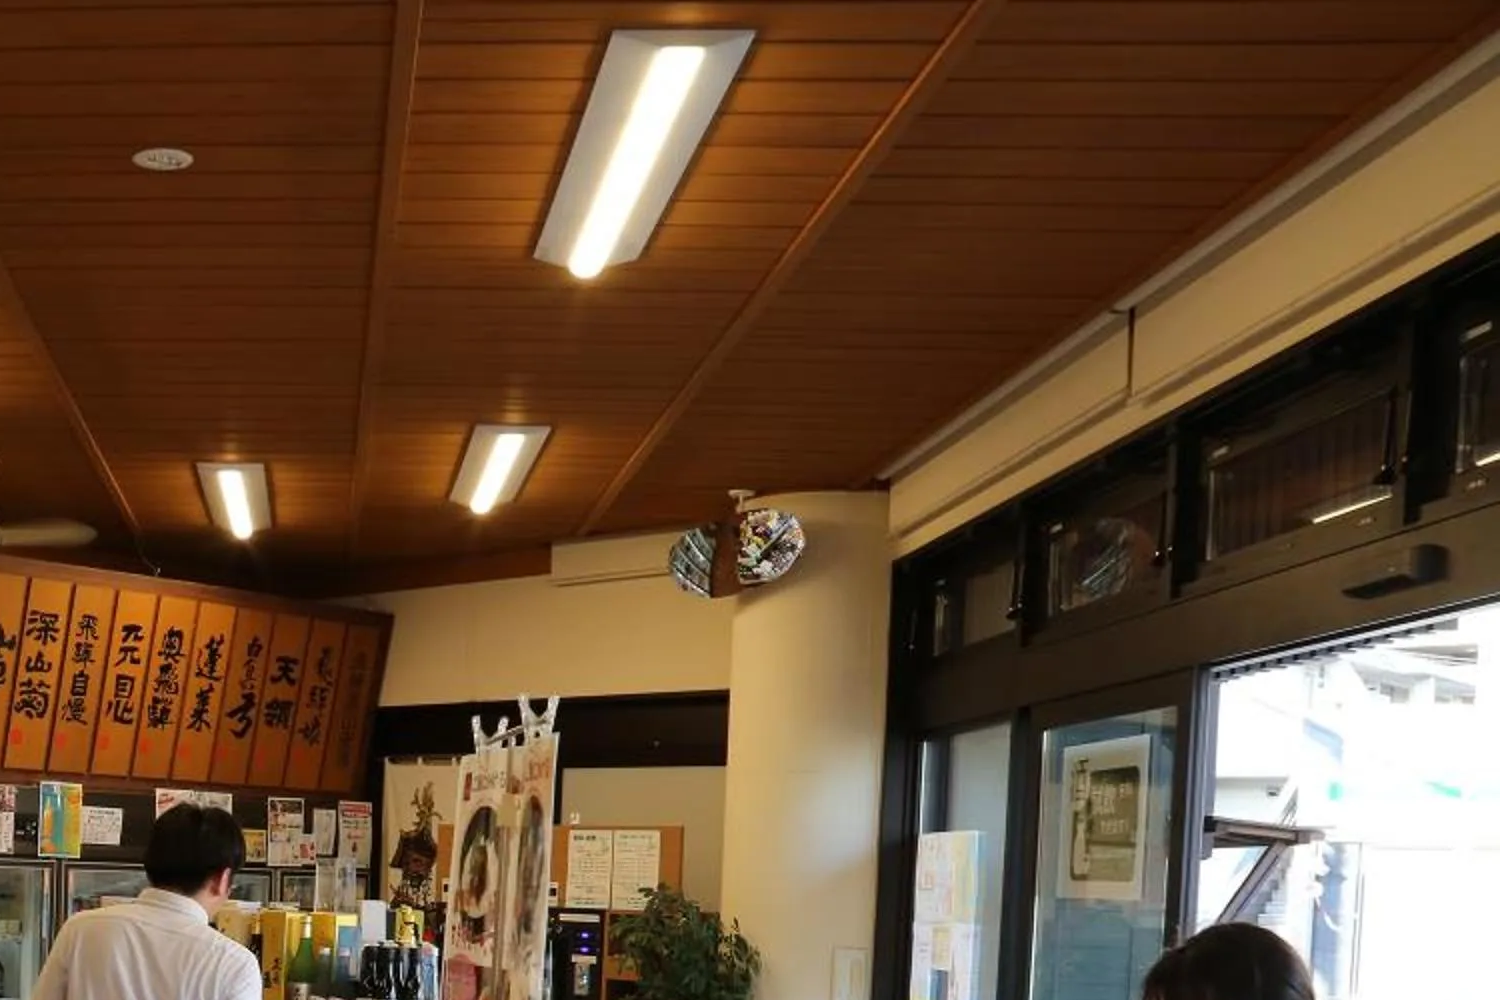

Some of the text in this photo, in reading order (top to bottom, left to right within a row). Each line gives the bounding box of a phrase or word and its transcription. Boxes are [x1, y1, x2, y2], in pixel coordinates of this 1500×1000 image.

[14, 610, 60, 720] 深山菊
[61, 614, 99, 725] 飛騨自慢
[147, 626, 187, 731] 奥飛騨
[187, 633, 224, 733] 蓬莱
[264, 656, 299, 730] 天領
